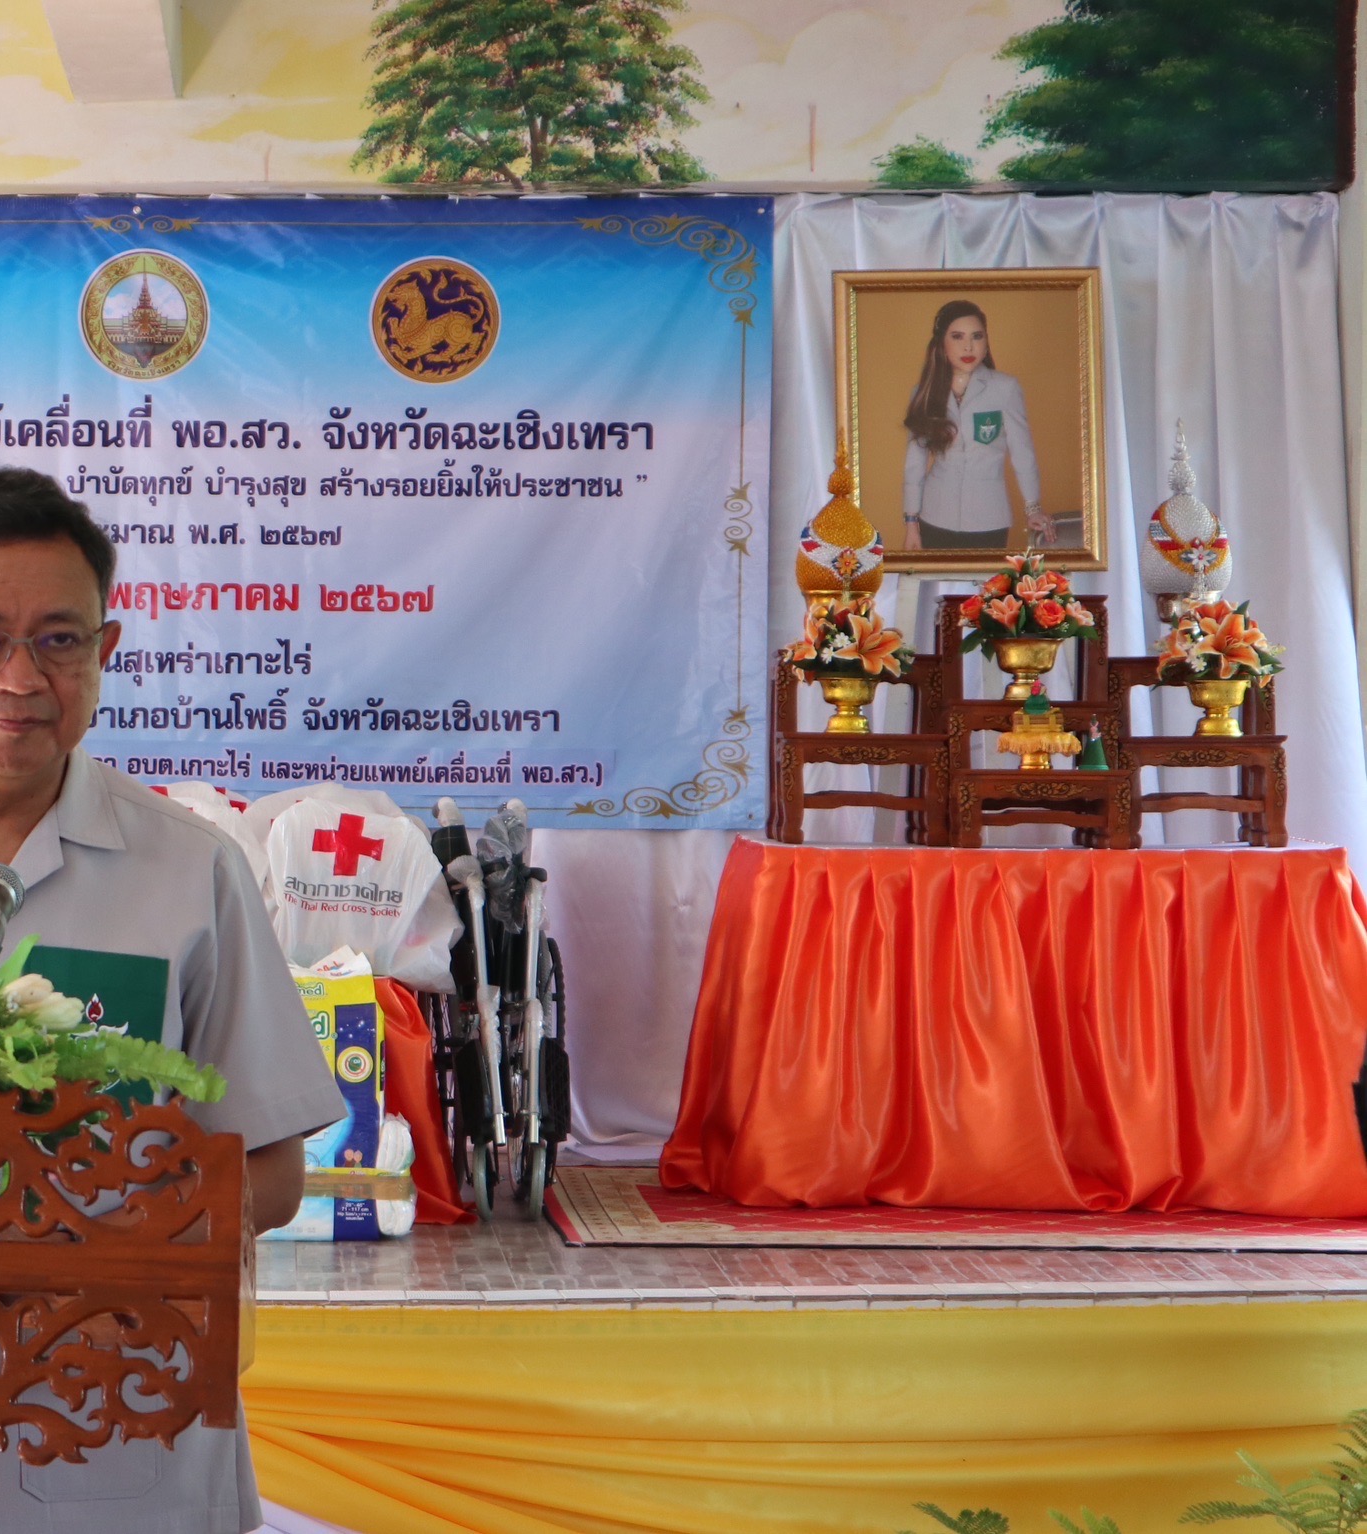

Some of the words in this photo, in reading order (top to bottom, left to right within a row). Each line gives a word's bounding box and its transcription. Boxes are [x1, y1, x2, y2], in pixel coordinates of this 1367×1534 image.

[172, 418, 301, 450] พอ.สว.
[322, 406, 654, 451] จังหวัดฉะเชิงเทรา
[67, 465, 193, 507] บำบัดทุกข์
[205, 466, 307, 508] บำรุงสุข
[319, 458, 624, 498] สร้างรอยยิ้มให้ประชาชน
[188, 522, 247, 546] พ.ศ.
[259, 524, 343, 547] ๒๕๖๗
[108, 581, 300, 620] พฤษภาคม
[318, 583, 435, 613] ๒๕๖๗
[302, 697, 561, 732] จังหวัดฉะเชิงเทรา
[127, 749, 251, 778] อบต.เกาะไร่
[261, 751, 511, 783] และหน่วยแพทย์เคลื่อนที่
[521, 761, 603, 787] พอ.สว.)
[284, 892, 298, 905] The
[301, 899, 318, 912] Thai
[321, 902, 339, 912] Red
[342, 903, 367, 914] Cross
[370, 907, 402, 918] Society
